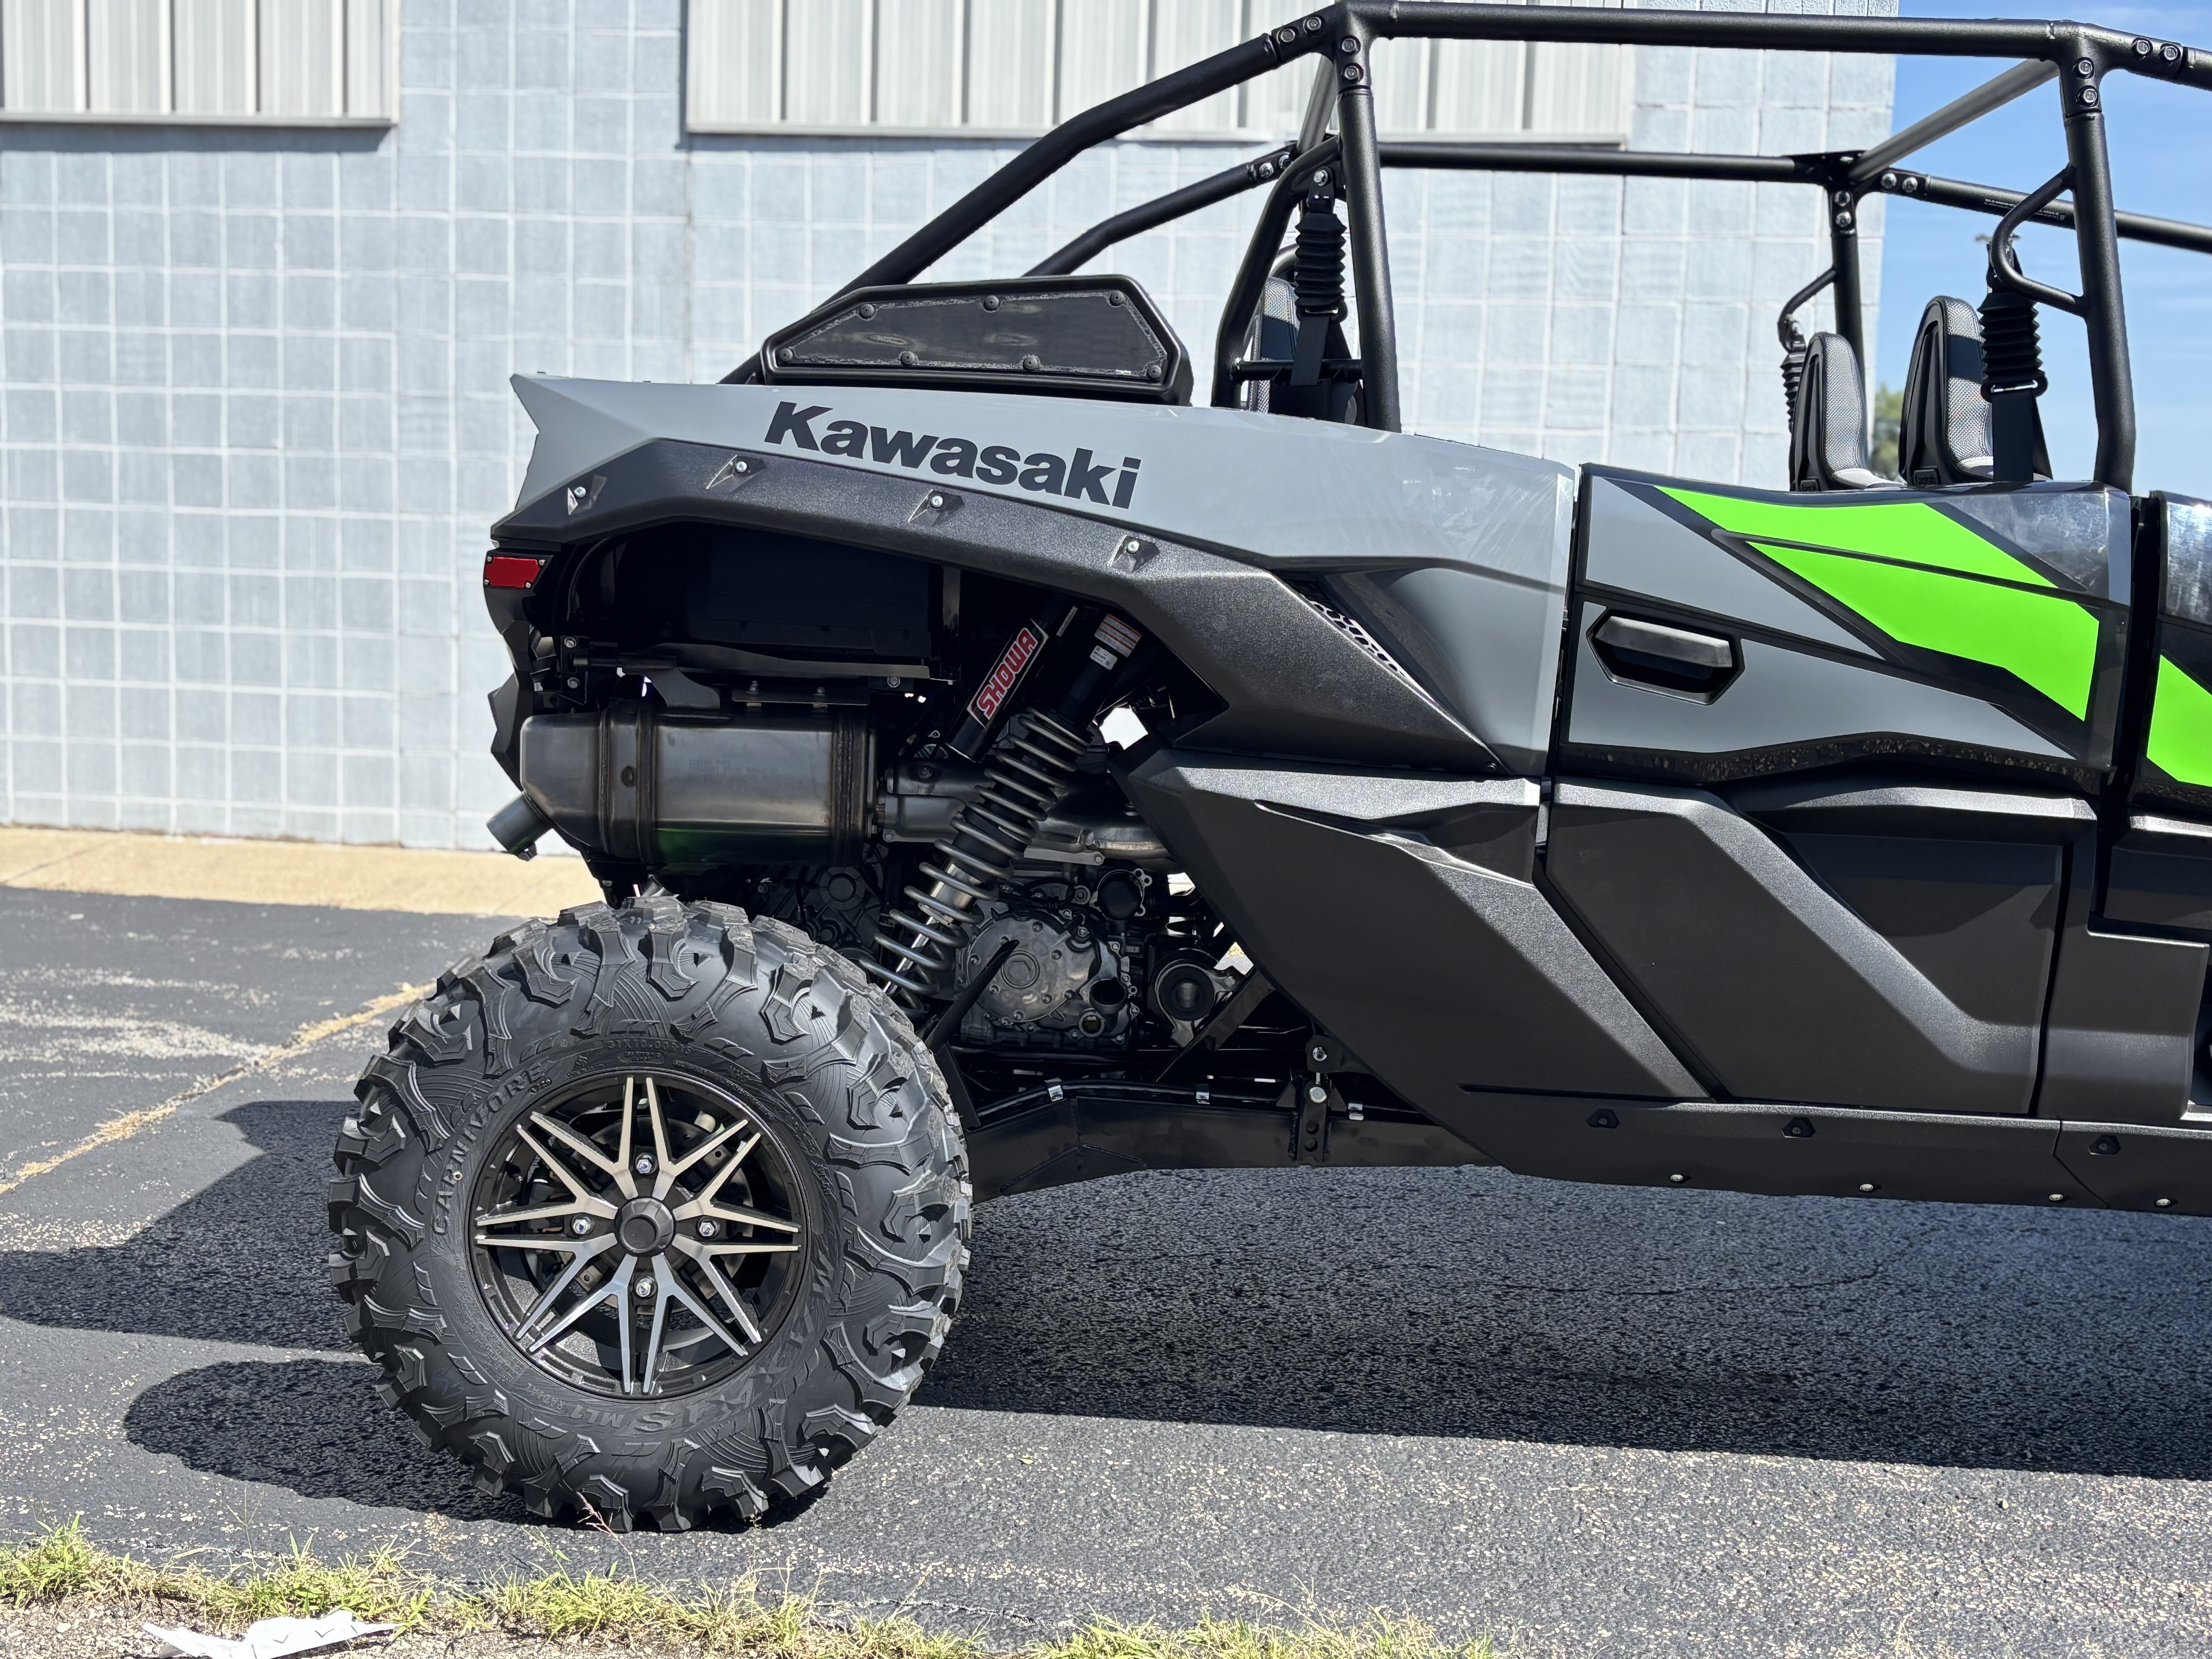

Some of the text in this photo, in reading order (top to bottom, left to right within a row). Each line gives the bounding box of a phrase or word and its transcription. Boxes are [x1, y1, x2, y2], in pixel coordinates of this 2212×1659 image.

[764, 401, 1142, 509] Kawasaki
[976, 627, 1039, 721] SHOWA
[431, 1060, 547, 1236] CARNIVORE
[525, 1382, 566, 1410] RADIAL
[569, 1404, 624, 1428] ML1
